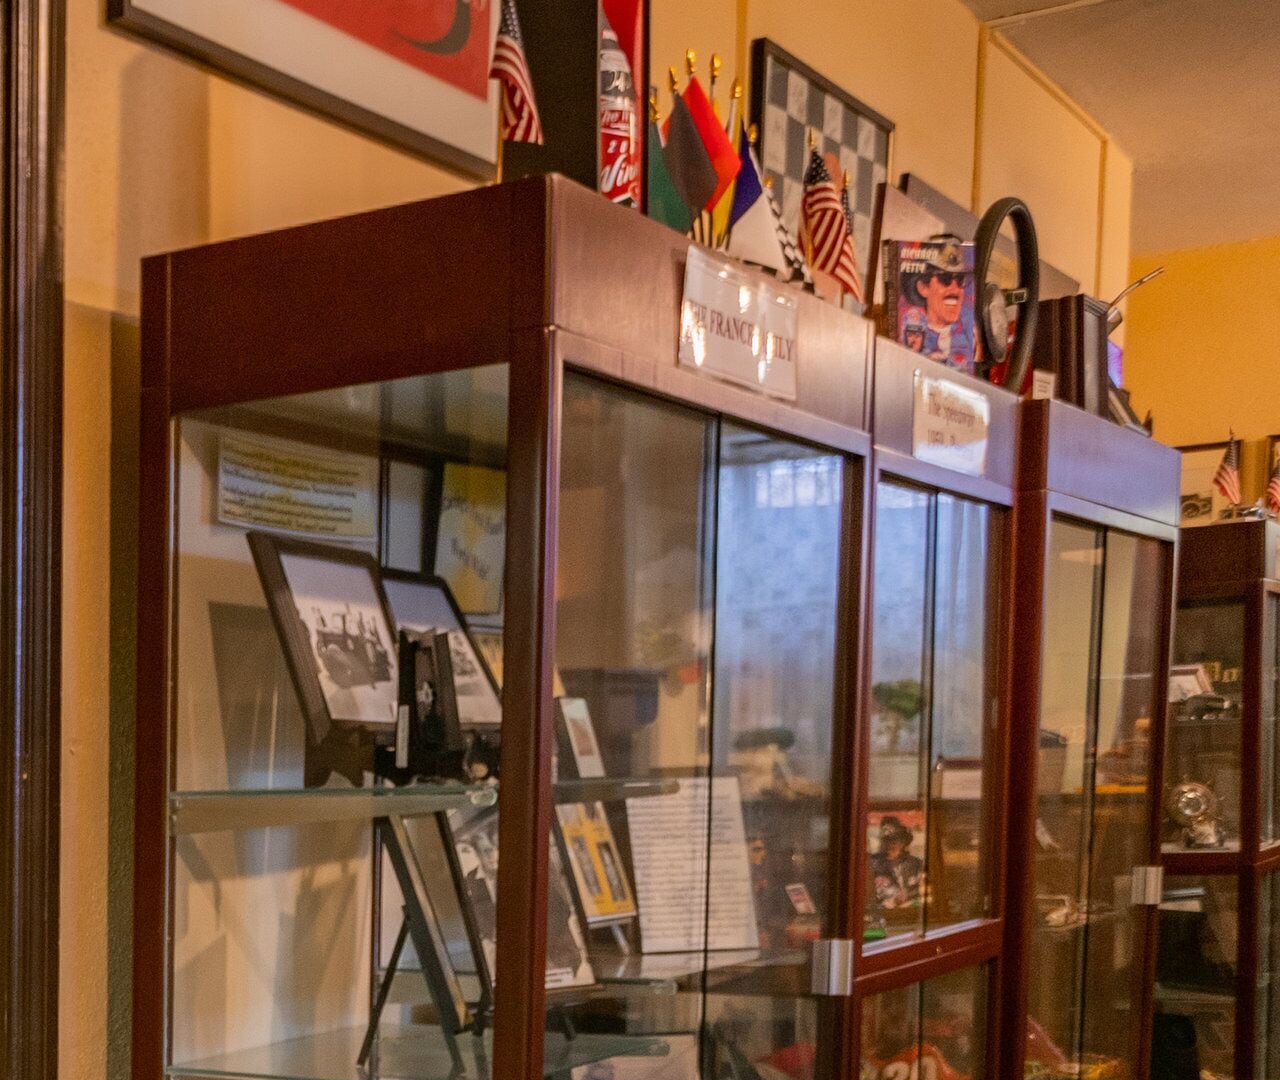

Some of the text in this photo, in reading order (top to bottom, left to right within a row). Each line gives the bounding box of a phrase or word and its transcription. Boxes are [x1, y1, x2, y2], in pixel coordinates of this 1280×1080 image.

[900, 247, 940, 259] RICHARD
[900, 261, 926, 273] PETTY
[710, 309, 756, 347] FRANCE
